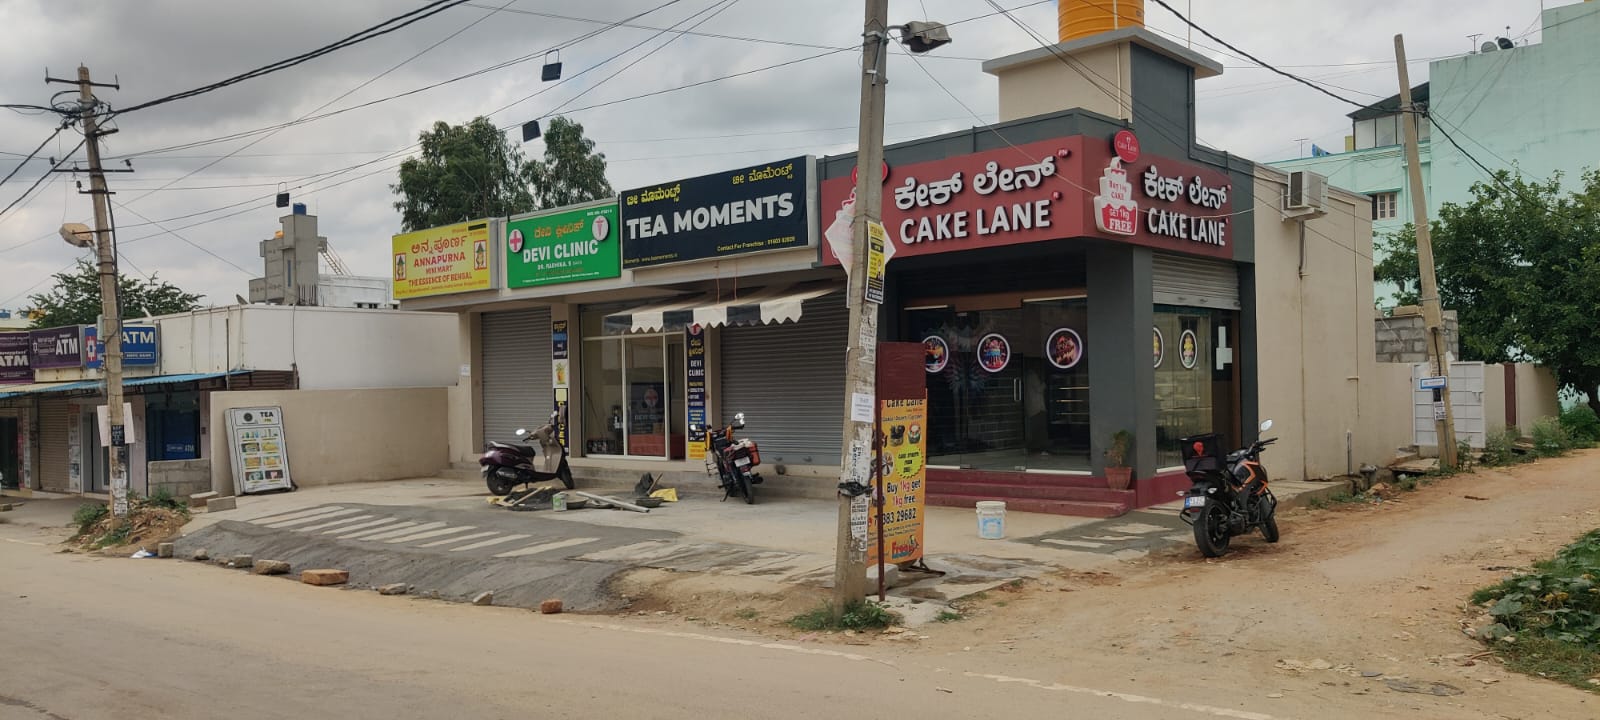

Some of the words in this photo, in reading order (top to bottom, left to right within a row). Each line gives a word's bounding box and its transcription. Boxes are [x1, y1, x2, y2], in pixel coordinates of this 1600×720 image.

[894, 172, 963, 210] ಕೇಕ್
[973, 157, 1055, 195] ಲೇನ್
[1144, 165, 1184, 202] ಕೇಕ್
[1189, 176, 1227, 210] ಲೇನ್
[627, 214, 668, 240] TEA
[673, 193, 794, 233] MOMENTS
[900, 211, 968, 245] CAKE
[976, 200, 1051, 235] LANE
[1109, 218, 1132, 233] FREE
[1148, 208, 1187, 239] CAKE
[1191, 217, 1226, 247] LANE
[523, 245, 551, 263] DEVI
[554, 240, 599, 259] CLINIC
[414, 252, 466, 268] ANNAPURNA
[426, 266, 437, 274] MINI
[437, 265, 453, 273] MART
[408, 278, 419, 287] THE
[418, 275, 441, 285] ESSENCE
[123, 331, 154, 344] ATM
[56, 338, 78, 355] ATM
[0, 355, 29, 367] ATM
[689, 369, 704, 377] CLINIC
[887, 482, 898, 494] Buy
[900, 480, 910, 492] 1kg
[911, 479, 921, 491] get
[892, 497, 903, 508] 1kg
[903, 494, 915, 504] free
[896, 508, 917, 525] 29682
